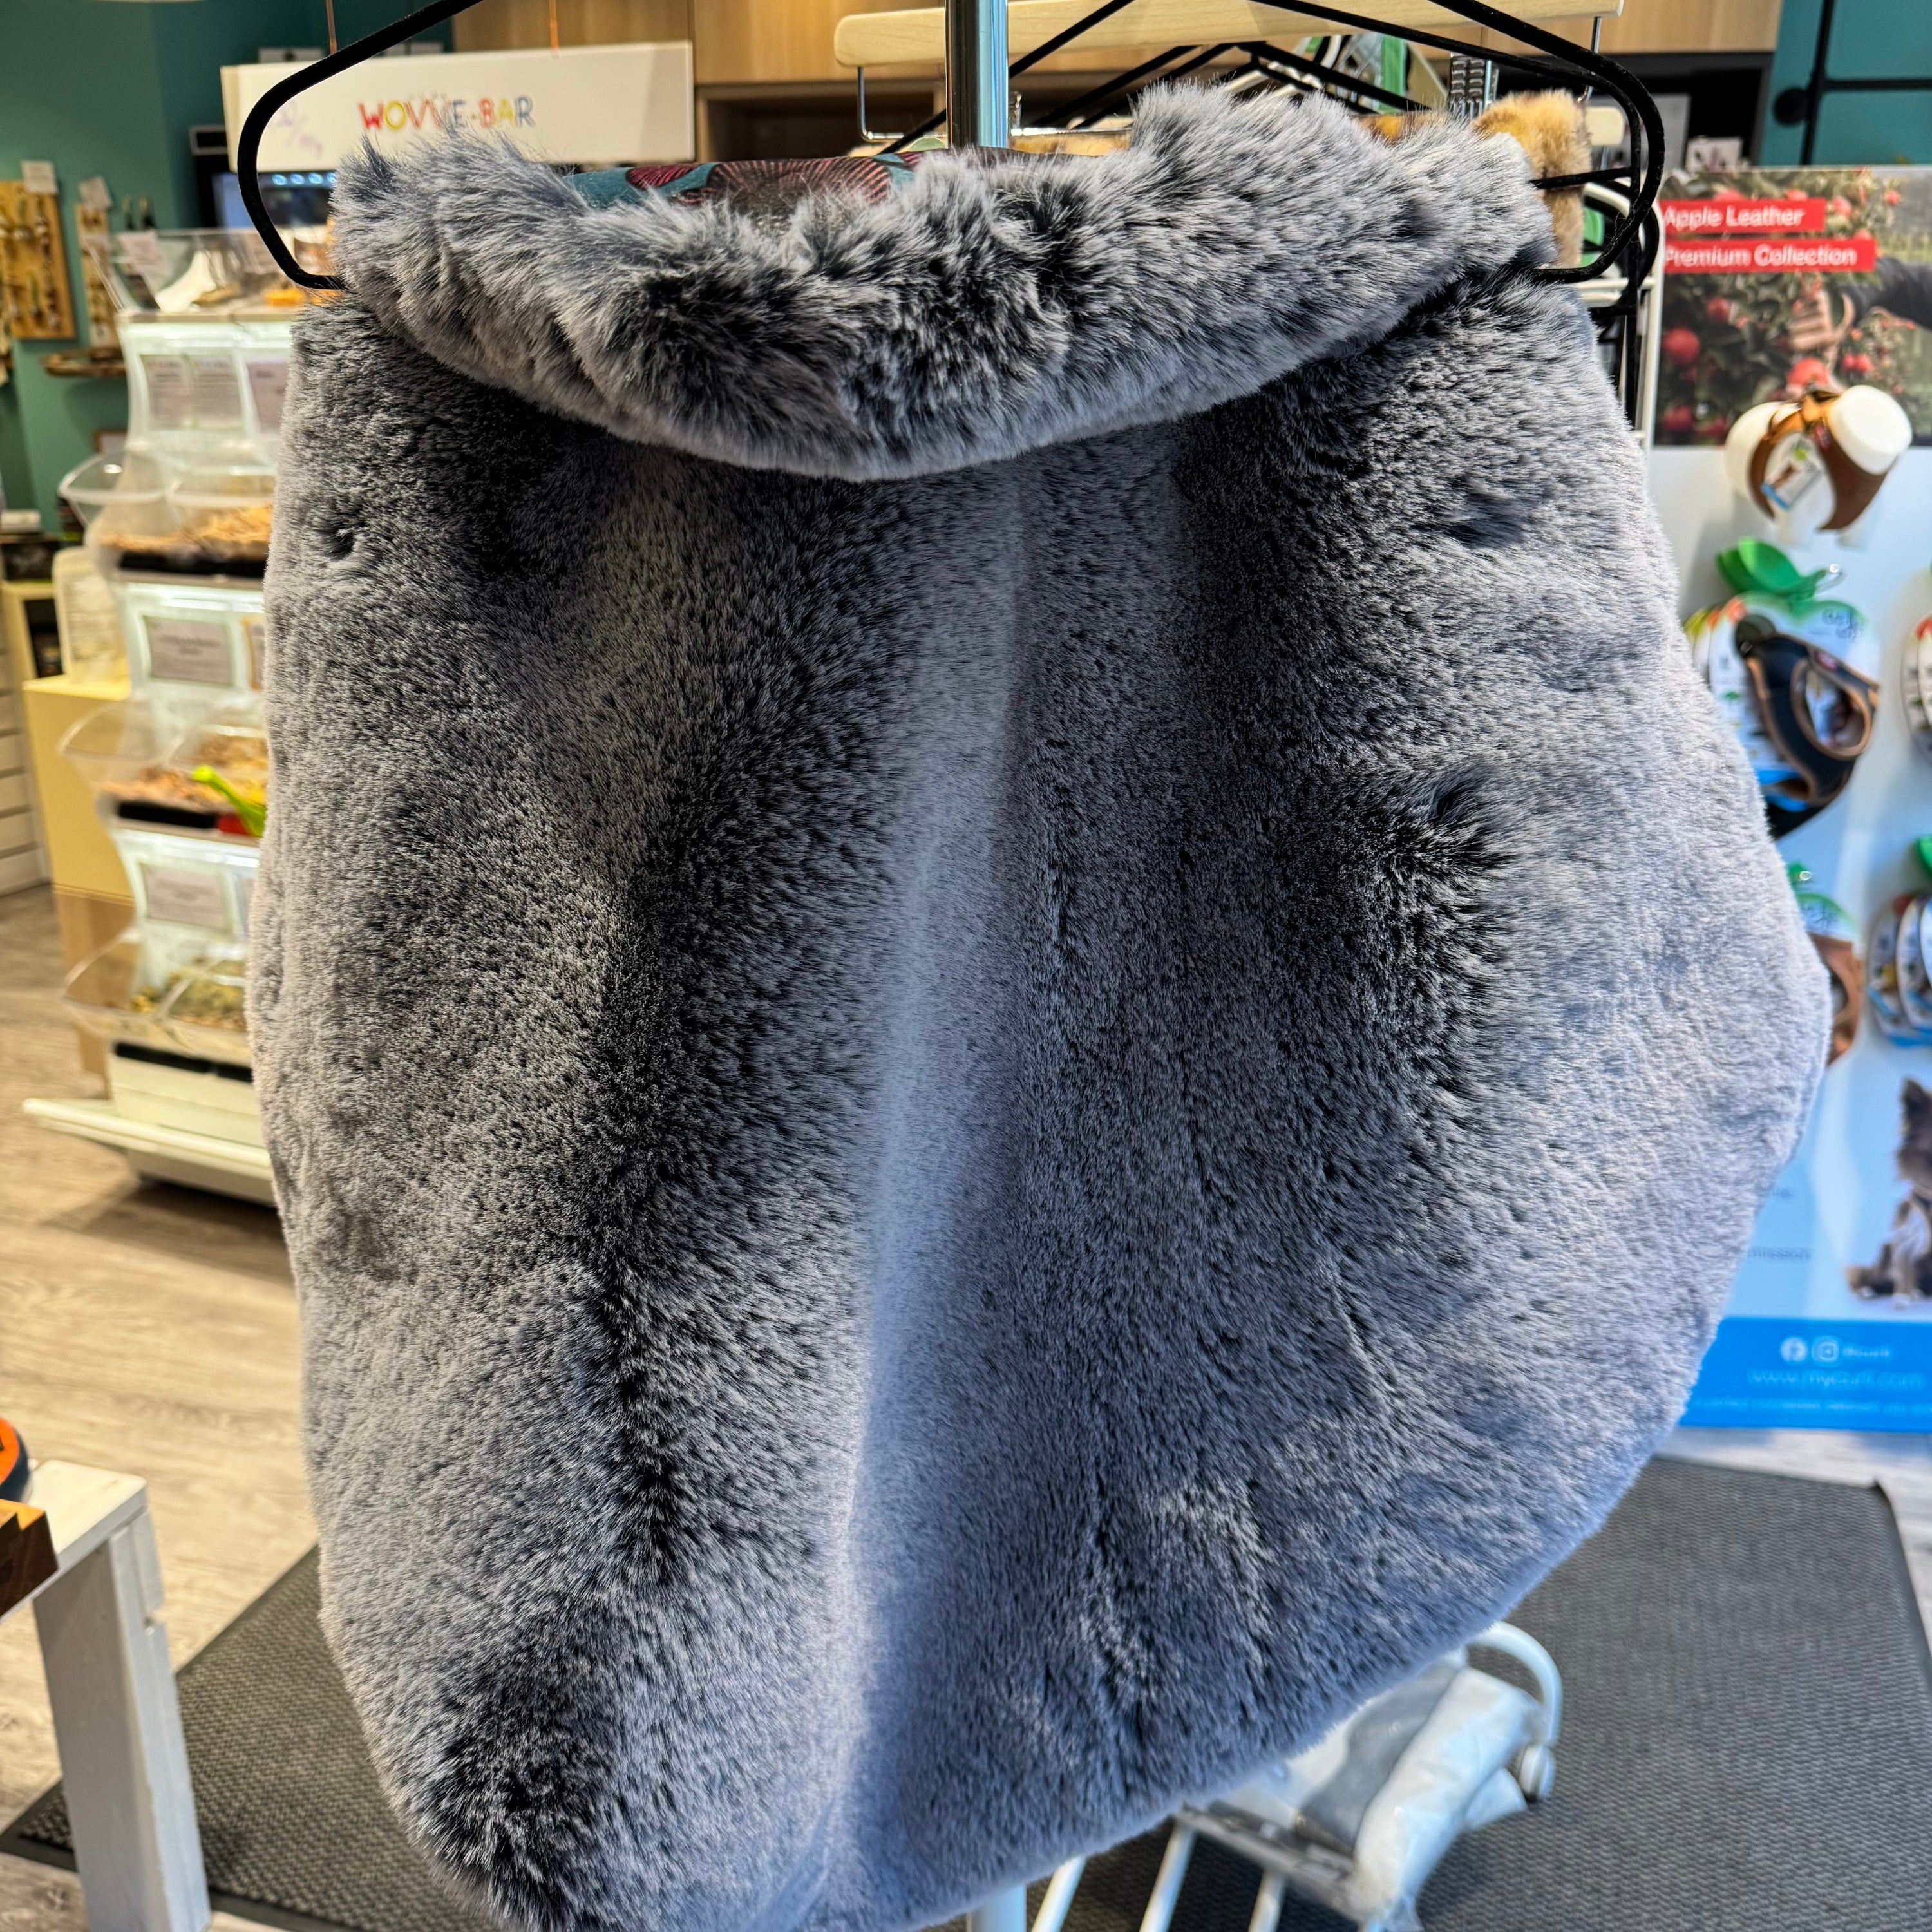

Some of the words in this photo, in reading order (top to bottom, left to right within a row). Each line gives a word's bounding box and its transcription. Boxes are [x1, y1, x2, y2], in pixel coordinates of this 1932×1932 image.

[1665, 205, 1723, 231] Apple
[1725, 205, 1805, 227] Leather
[1665, 244, 1751, 267] Premium
[1754, 243, 1858, 267] Collection
